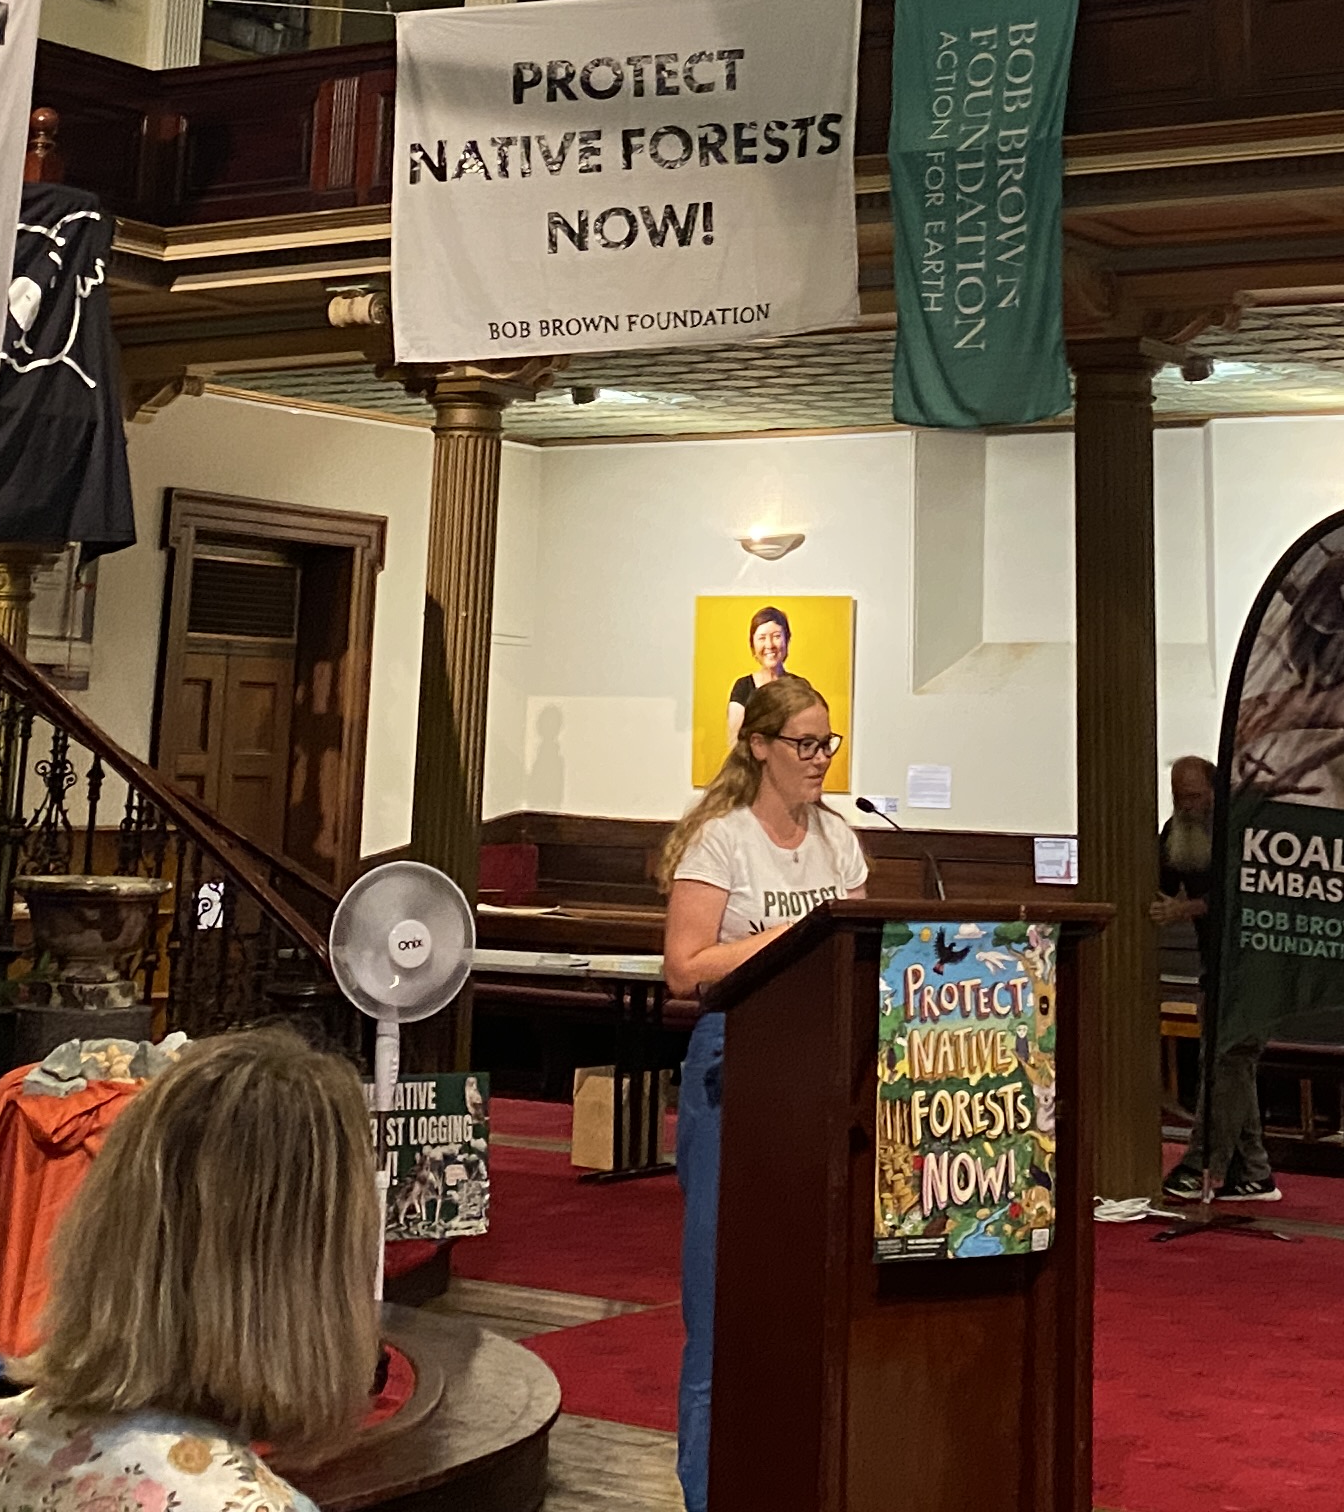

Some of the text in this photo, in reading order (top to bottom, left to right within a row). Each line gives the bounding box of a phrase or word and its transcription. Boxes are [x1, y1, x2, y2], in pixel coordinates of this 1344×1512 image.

[512, 49, 745, 105] PROTECT
[409, 113, 843, 184] NATIVE FORESTS
[921, 31, 958, 312] ACTION FOR EARTH
[996, 17, 1038, 309] BOB BROWN
[954, 25, 998, 351] FOUNDATION
[547, 201, 715, 255] NOW!
[488, 303, 771, 340] BOB BROWN FOUNDATION
[1241, 908, 1289, 931] BOB
[908, 1027, 1012, 1081] NATIVE
[394, 1081, 436, 1111] ATIVE
[911, 1082, 1032, 1147] FORESTS
[409, 1114, 473, 1145] LOGGING
[922, 1149, 1016, 1217] NOW!
